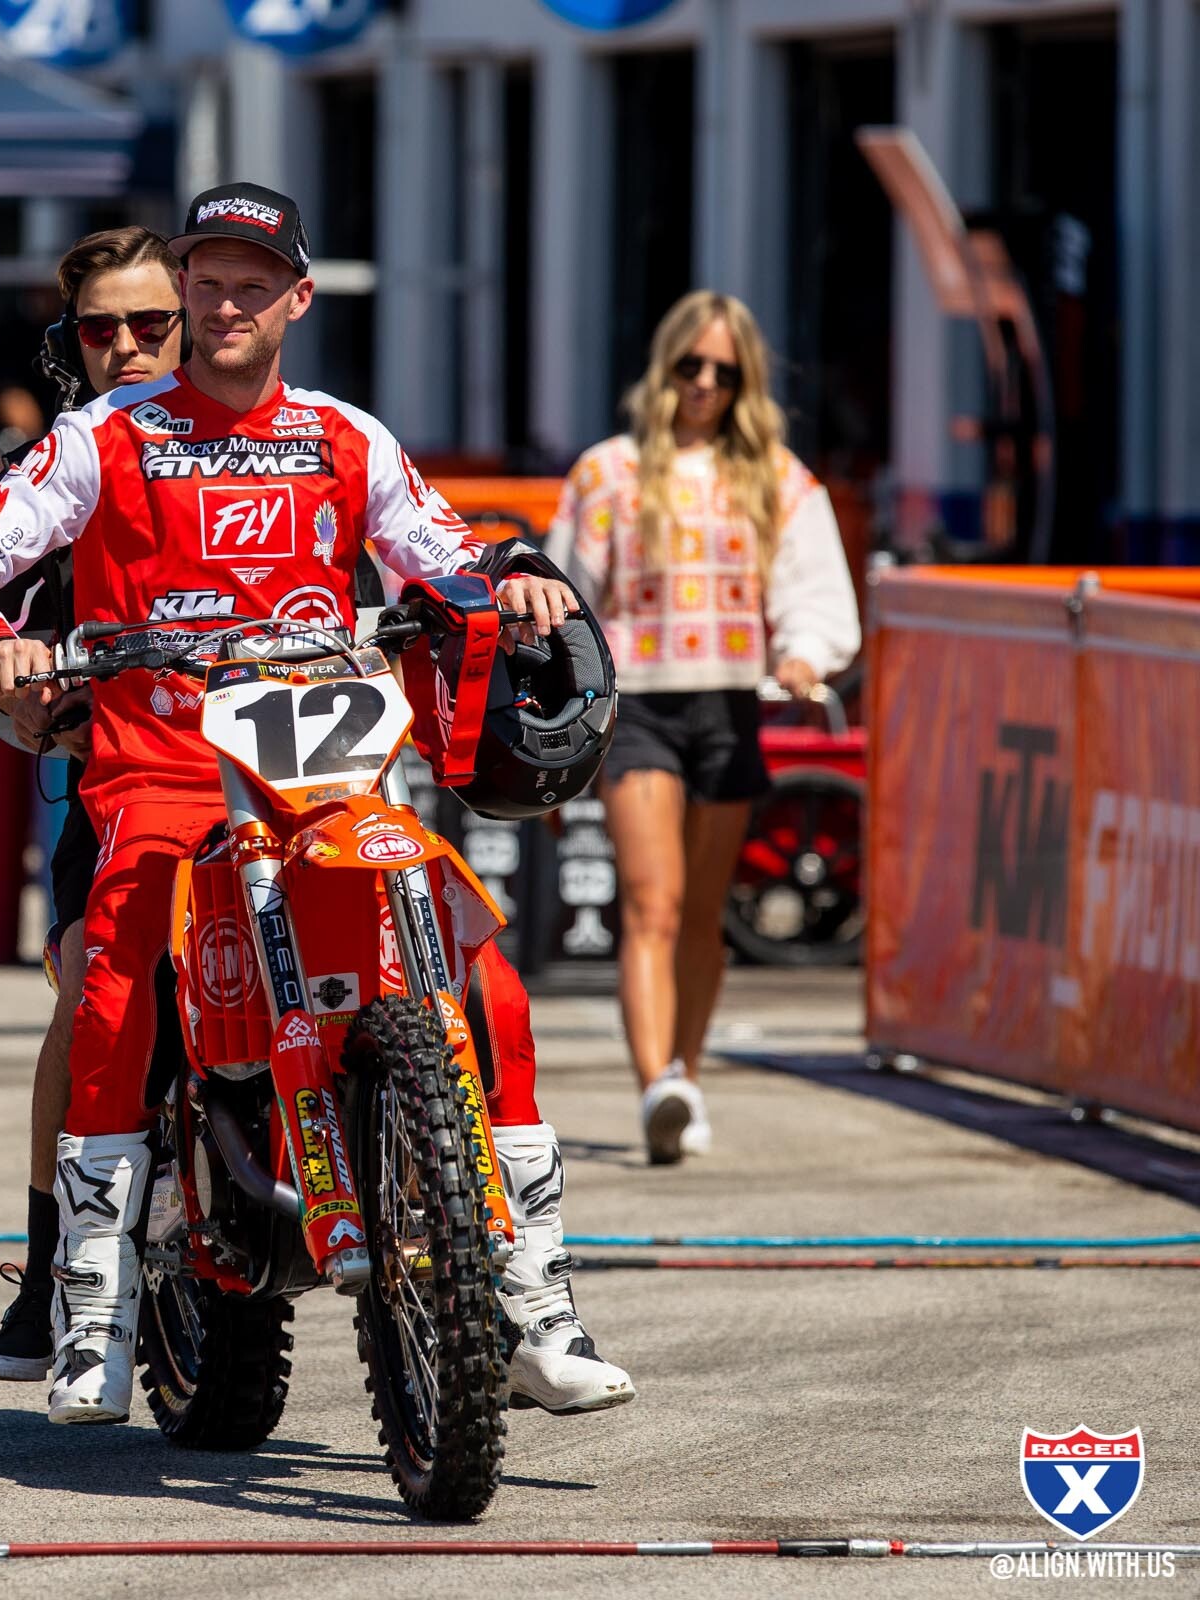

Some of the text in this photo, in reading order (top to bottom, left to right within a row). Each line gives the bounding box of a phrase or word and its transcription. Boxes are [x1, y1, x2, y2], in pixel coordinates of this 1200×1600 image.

[232, 197, 280, 217] MOUNTAIN
[164, 436, 320, 456] ROCKY MOUNTAIN
[210, 495, 285, 547] FLY
[407, 523, 452, 565] SWEET
[148, 590, 236, 621] KTM
[268, 663, 338, 677] MONSTER
[465, 629, 494, 683] FLY
[30, 671, 56, 683] ASV
[234, 681, 388, 783] 12
[968, 722, 1073, 950] KTM
[277, 1035, 323, 1054] DUBYA
[321, 1087, 354, 1195] DUNLOP
[300, 1157, 314, 1196] USA
